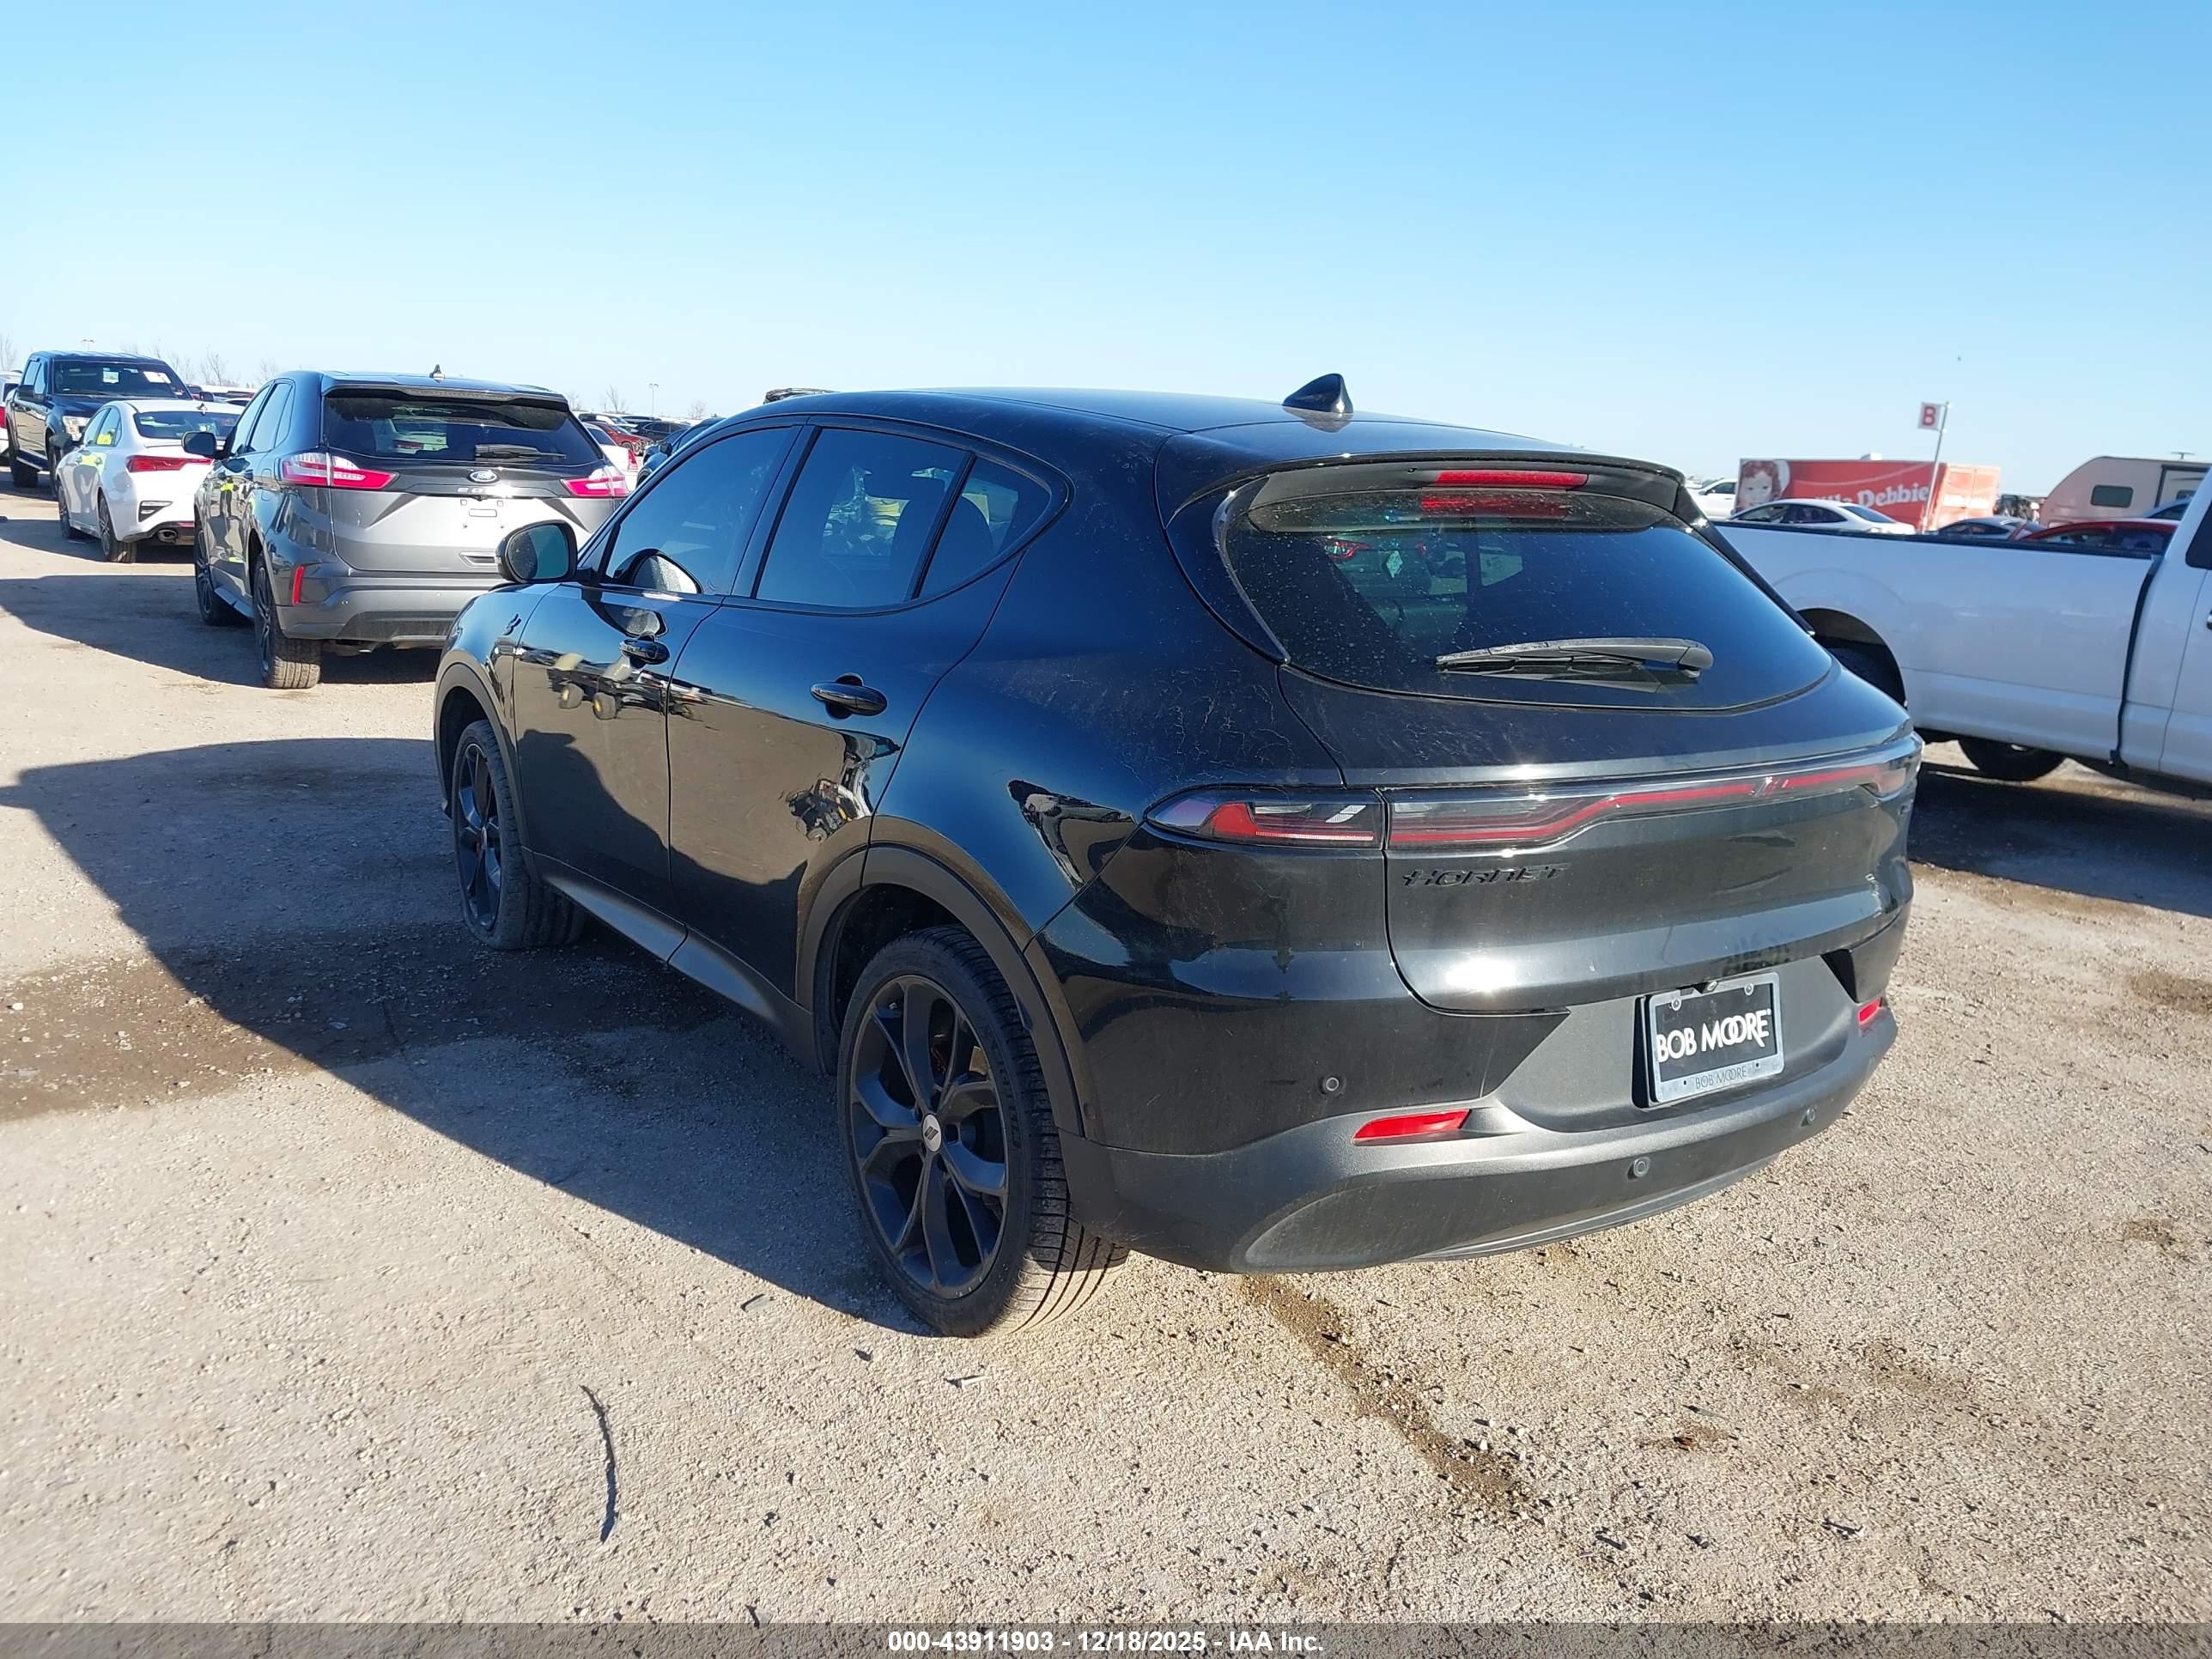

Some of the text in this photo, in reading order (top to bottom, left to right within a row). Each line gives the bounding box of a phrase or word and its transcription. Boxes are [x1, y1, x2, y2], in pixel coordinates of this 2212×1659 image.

[1923, 406, 1936, 426] B
[1857, 483, 1929, 508] Debbie
[1402, 863, 1571, 887] HORNET
[1656, 1009, 1771, 1063] BOB MOORE
[1695, 1065, 1747, 1090] BOB MOORE
